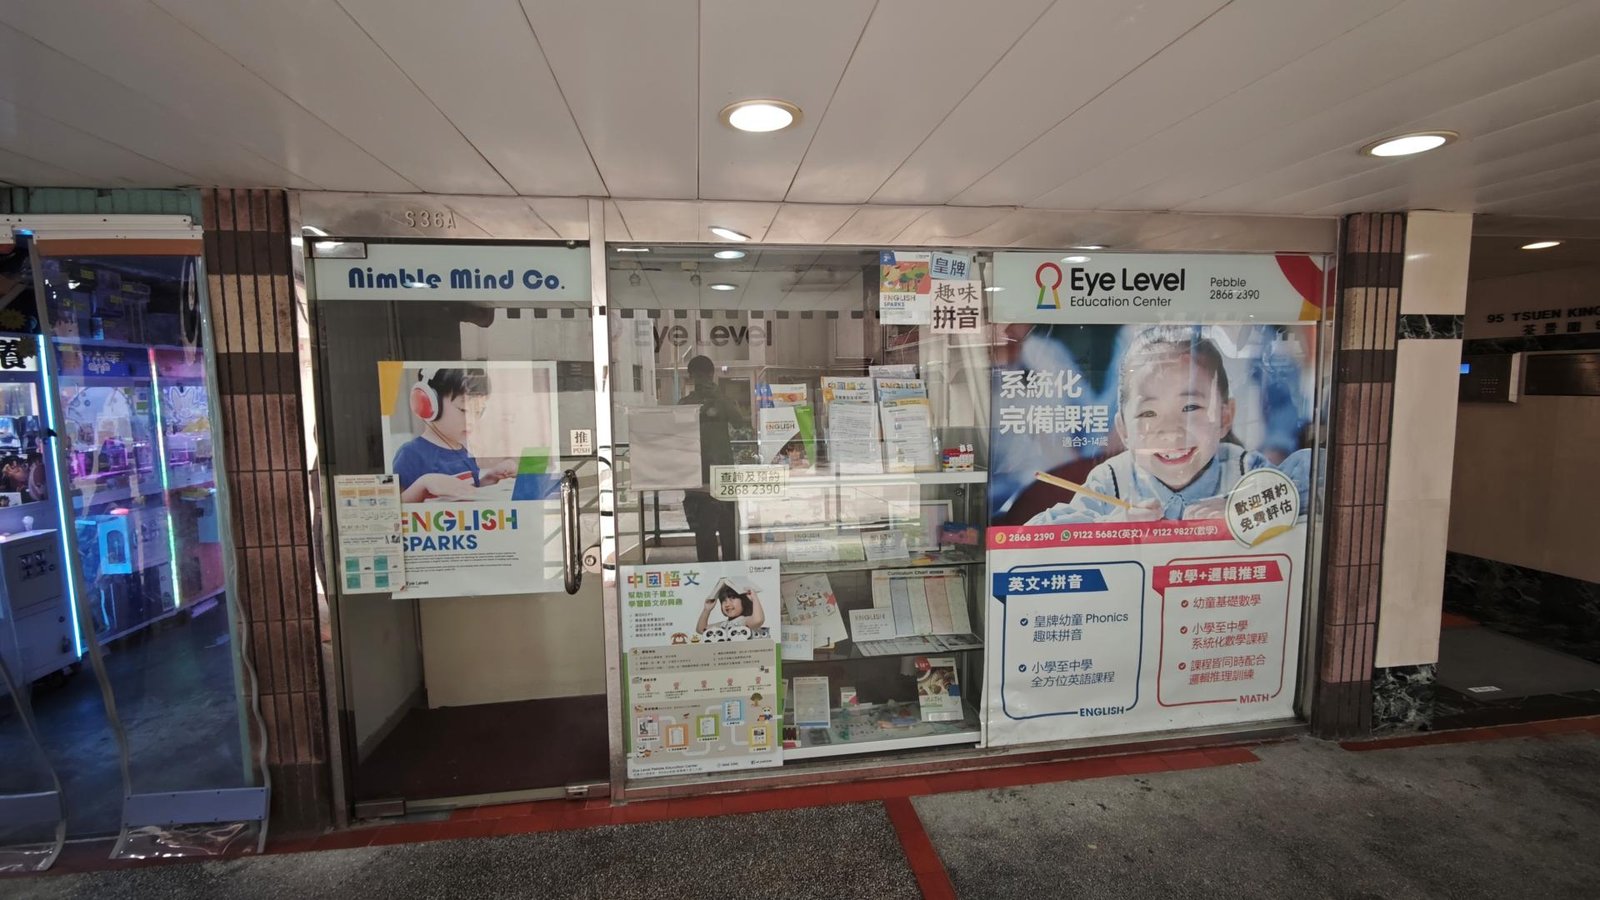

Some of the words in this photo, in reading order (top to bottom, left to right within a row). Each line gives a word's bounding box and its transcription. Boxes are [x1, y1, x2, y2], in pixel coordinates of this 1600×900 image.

[406, 210, 456, 229] S36A
[933, 257, 966, 278] 皇牌
[349, 267, 442, 289] Nimble
[450, 268, 514, 290] Mind
[522, 269, 565, 290] Co.
[1070, 267, 1116, 296] Eye
[1122, 267, 1186, 291] Level
[1210, 276, 1247, 288] Pebble
[935, 283, 979, 303] 趣味
[1210, 289, 1233, 300] 2868
[1236, 289, 1260, 300] 2390
[1070, 296, 1130, 308] Education
[1133, 296, 1172, 307] Center
[933, 306, 979, 329] 拼音
[1487, 314, 1505, 323] 95
[1512, 309, 1562, 322] TSUEN
[635, 320, 689, 353] Eye
[696, 320, 772, 347] Level
[1000, 370, 1082, 399] 系統化
[1000, 404, 1109, 434] 完備課程
[574, 431, 588, 444] 推
[720, 485, 749, 496] 2868
[752, 484, 781, 495] 2390
[1234, 482, 1289, 516] 歡迎預約
[400, 508, 518, 533] ENGLISH
[1240, 501, 1293, 532] 免費評估
[401, 534, 477, 552] SPARKS
[1008, 533, 1032, 542] 2868
[1034, 532, 1055, 542] 2390
[1073, 530, 1094, 539] 9122
[1153, 528, 1172, 537] 9122
[628, 570, 700, 589] 中國語文
[1008, 575, 1083, 592] 英文+拼音
[1193, 594, 1261, 609] 幼童基礎數學
[1034, 614, 1084, 628] 皇牌幼童
[1086, 612, 1129, 623] Phonics
[1192, 620, 1249, 635] 小學至中學
[1033, 629, 1083, 643] 趣味拼音
[1031, 659, 1093, 673] 小學至中學
[1031, 671, 1115, 688] 全方位英語課程
[1239, 693, 1270, 705] MATH
[1079, 706, 1125, 717] ENGLISH
